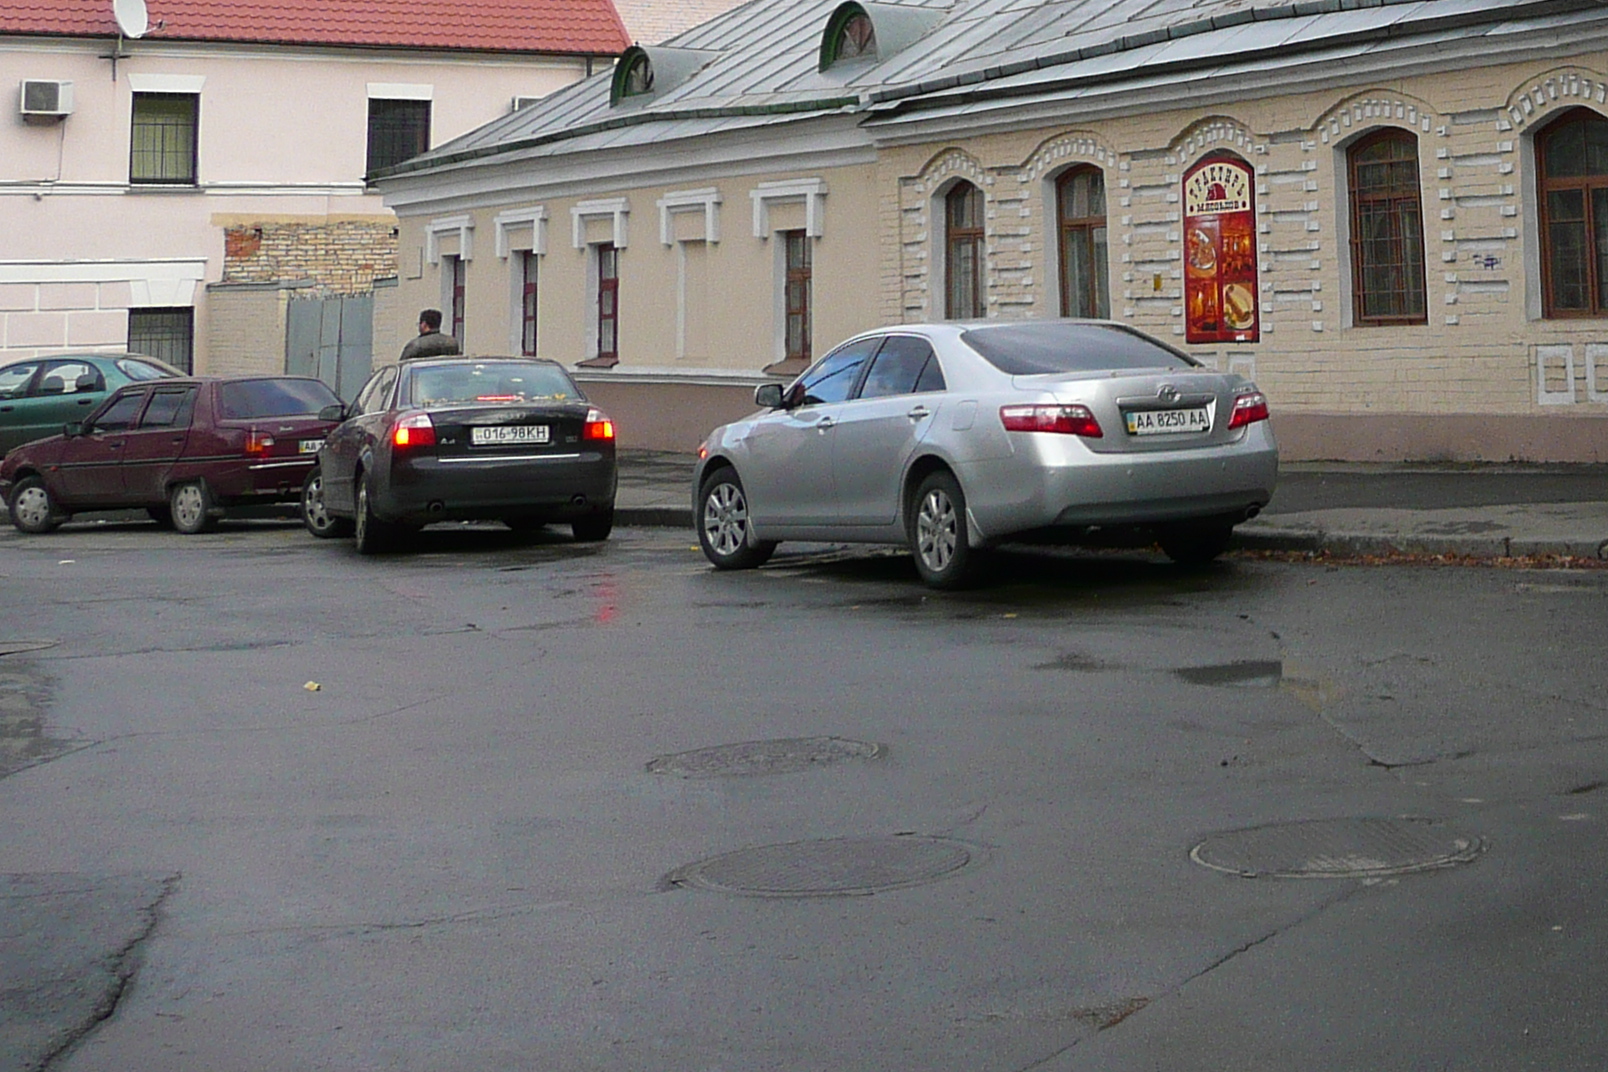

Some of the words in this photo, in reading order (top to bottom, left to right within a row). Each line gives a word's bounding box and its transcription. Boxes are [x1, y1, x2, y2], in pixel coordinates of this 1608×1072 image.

[1136, 413, 1154, 428] AA
[1157, 412, 1186, 427] 8250
[1189, 410, 1206, 425] AA
